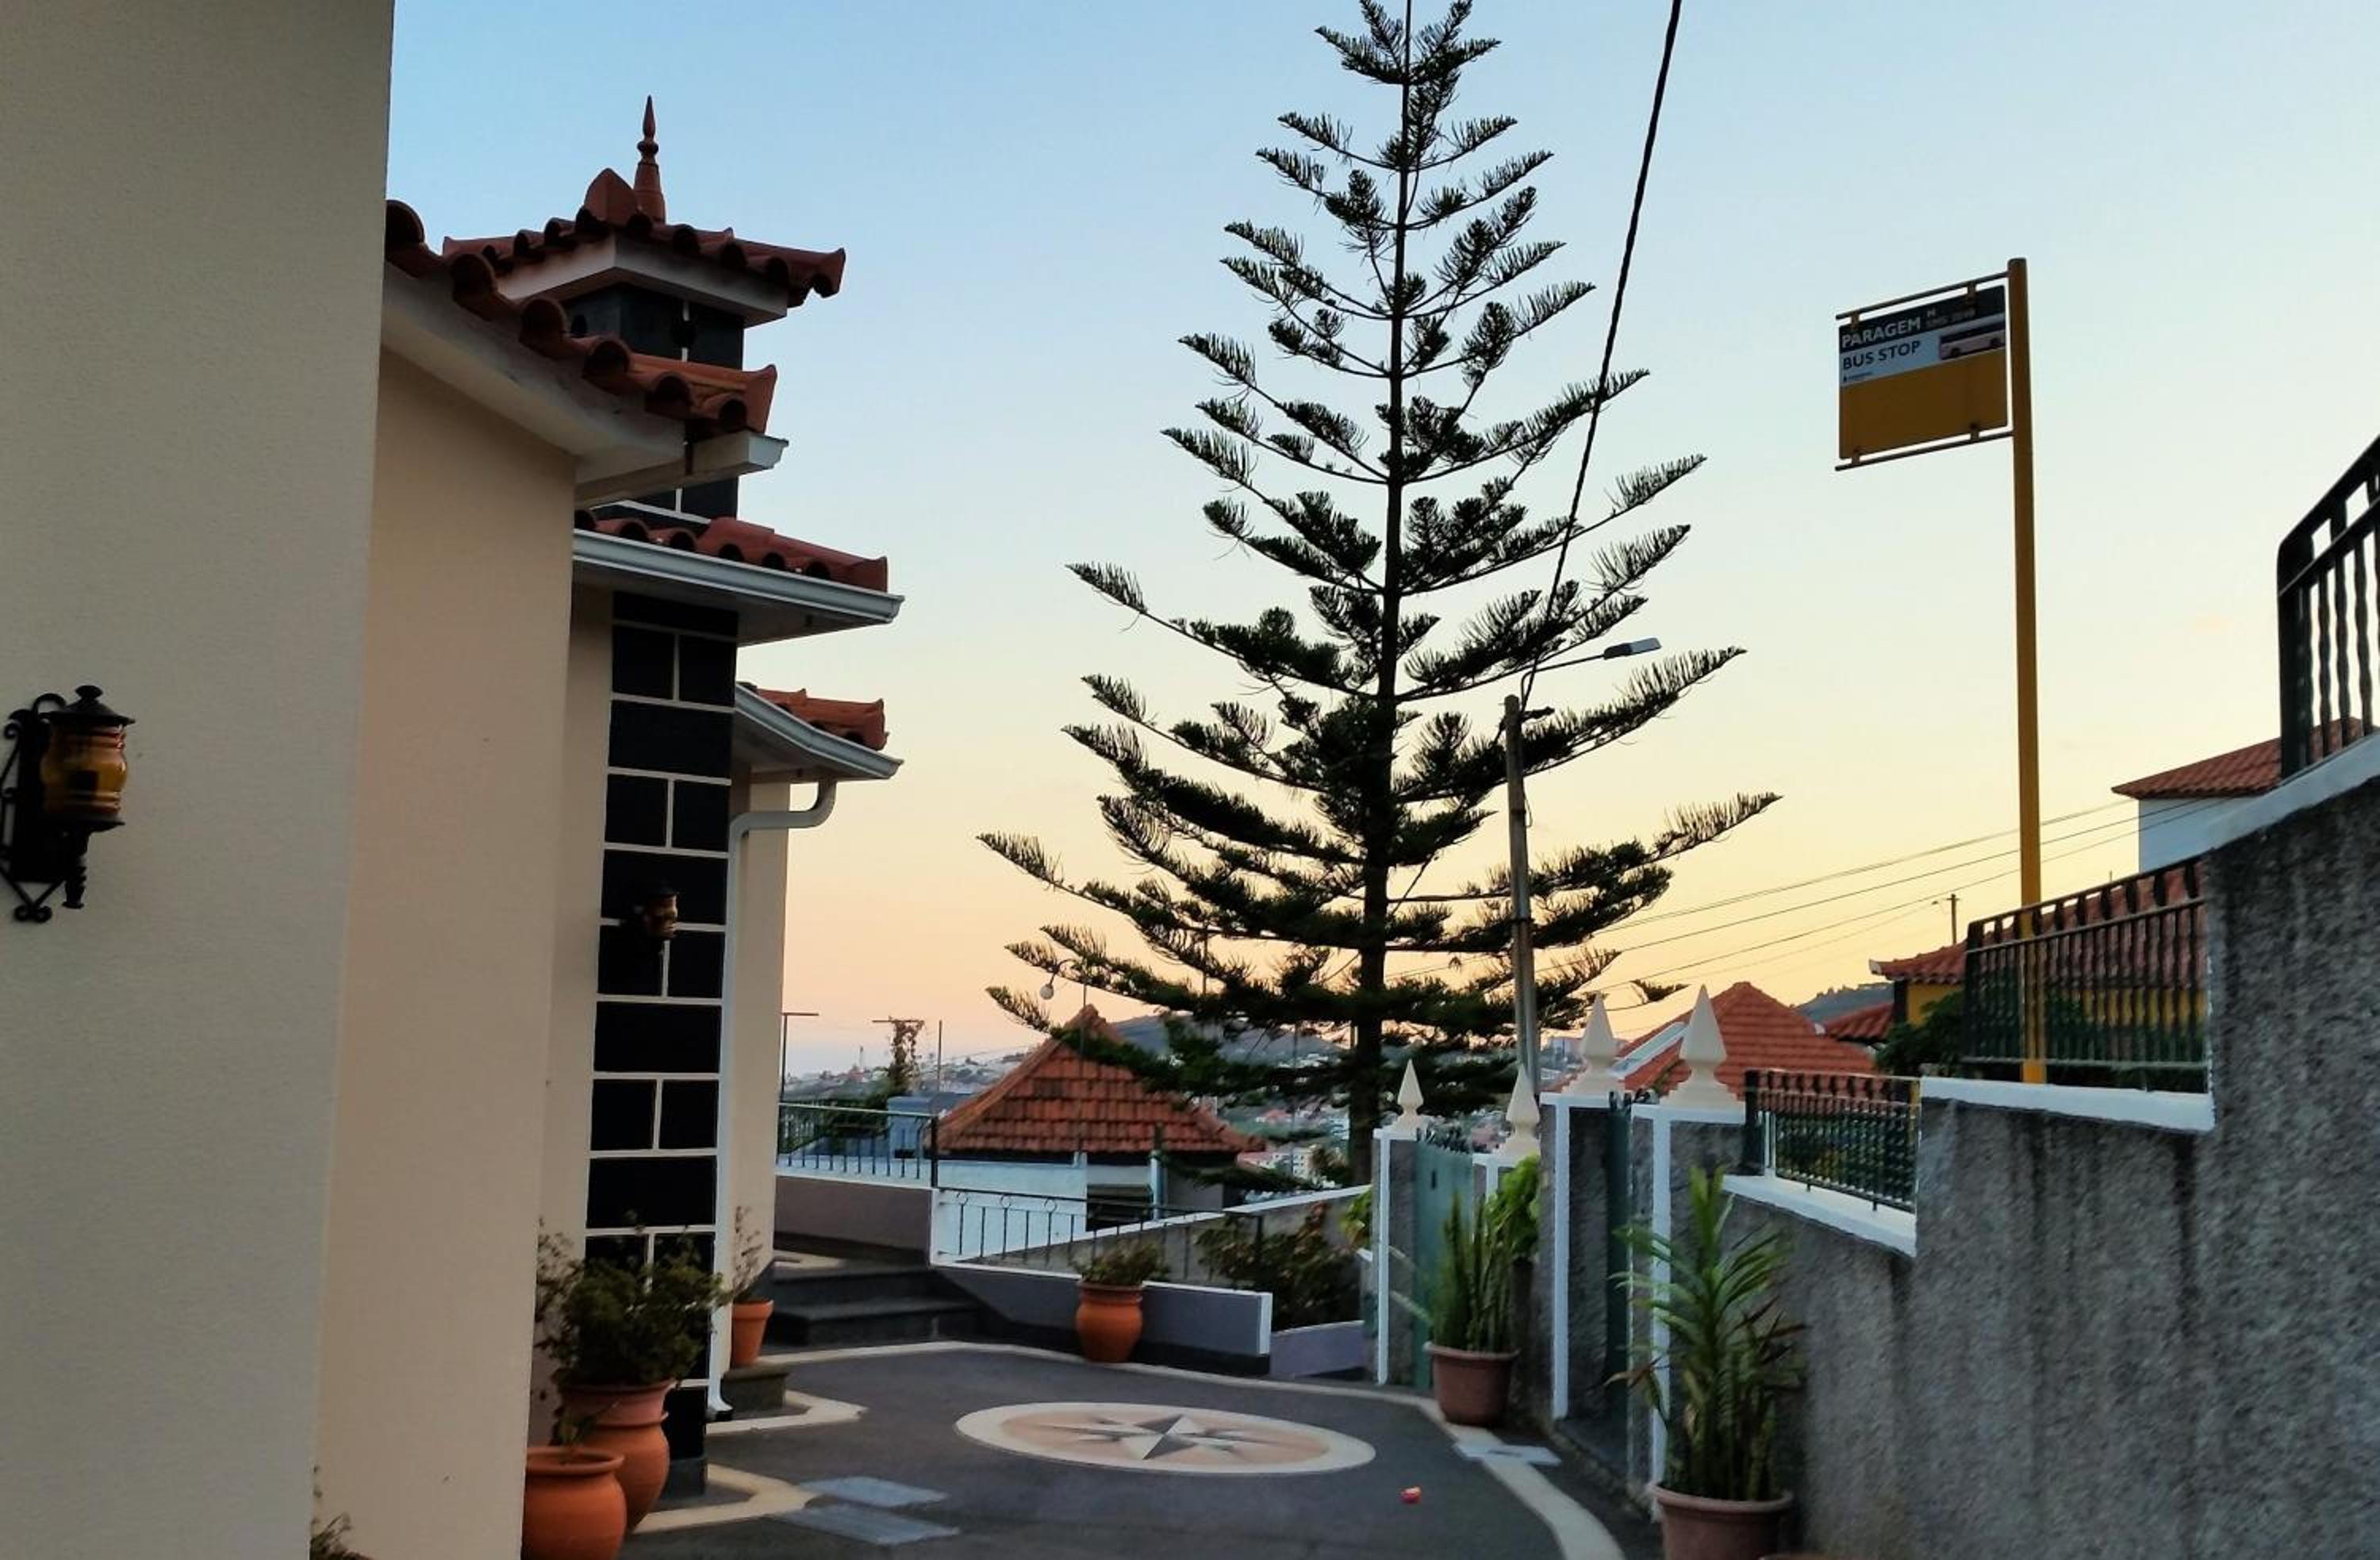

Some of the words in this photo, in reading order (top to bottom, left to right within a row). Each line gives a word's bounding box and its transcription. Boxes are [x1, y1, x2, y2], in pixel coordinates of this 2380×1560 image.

[1841, 317, 1921, 348] PARAGEM
[1843, 352, 1873, 370] BUS
[1878, 340, 1921, 362] STOP
